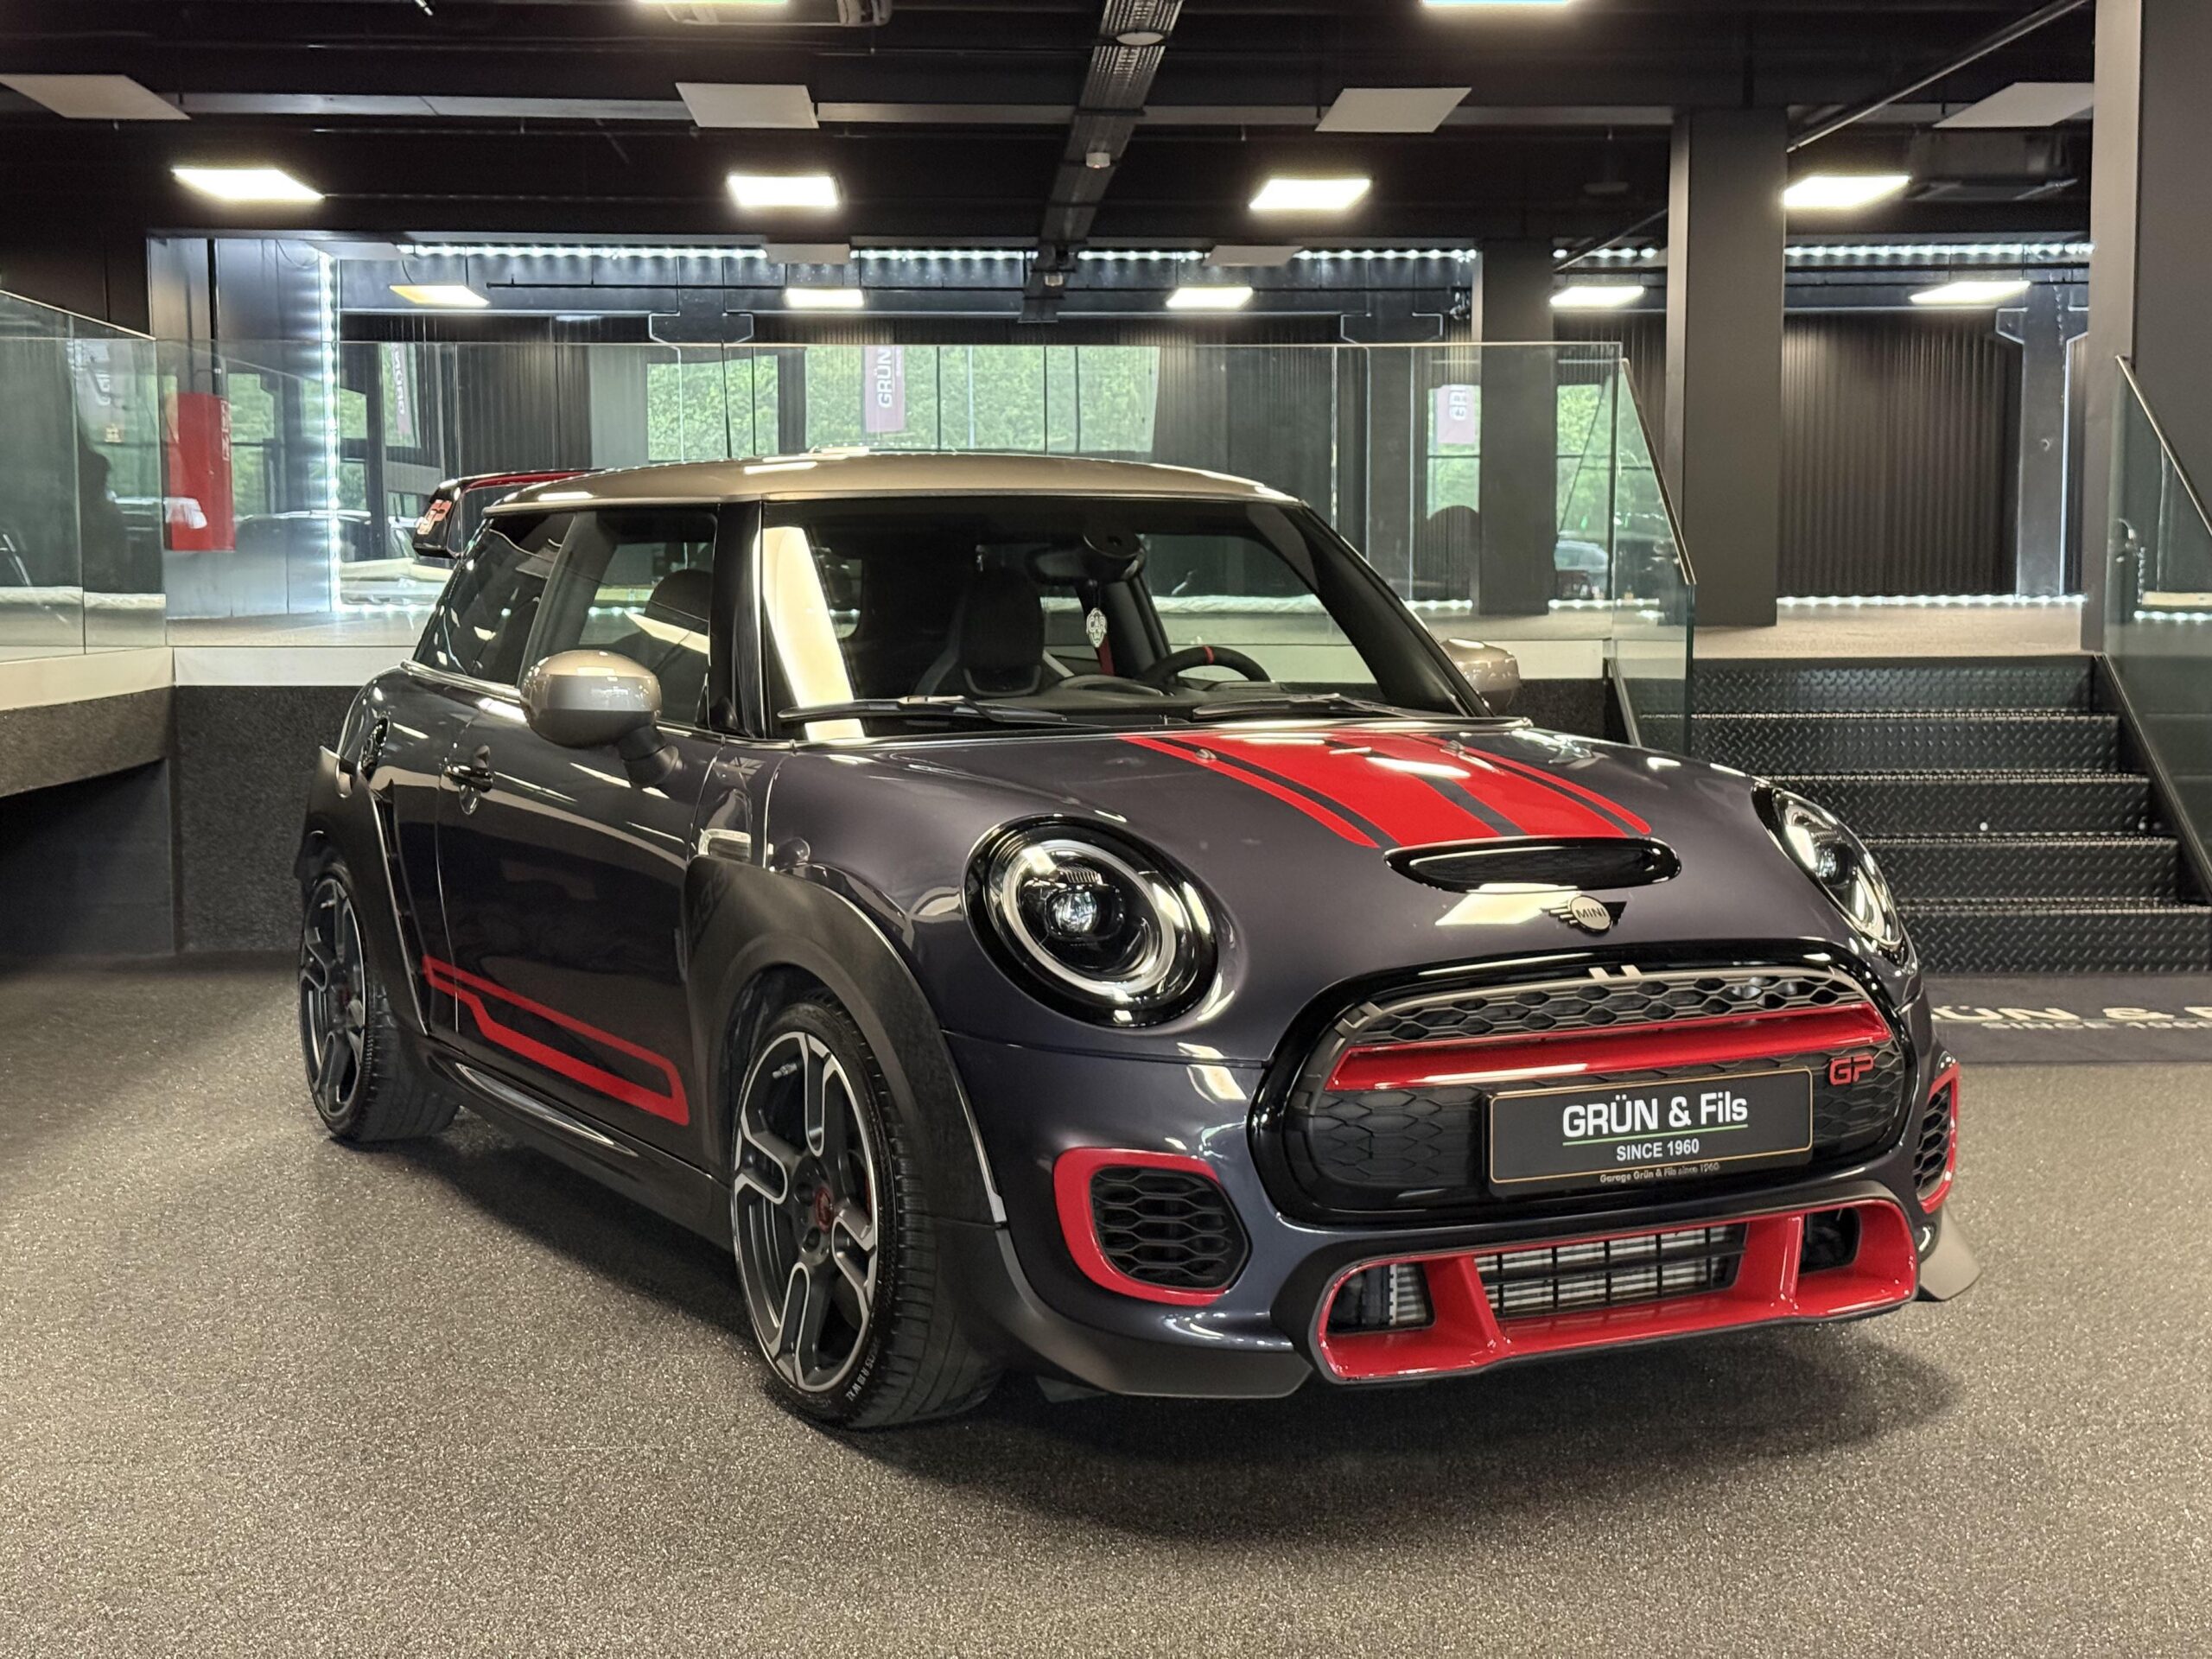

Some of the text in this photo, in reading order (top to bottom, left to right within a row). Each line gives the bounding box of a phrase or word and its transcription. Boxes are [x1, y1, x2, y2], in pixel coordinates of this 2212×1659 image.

[874, 347, 893, 407] GRÜN
[1575, 907, 1606, 918] MINI
[1930, 1006, 2081, 1020] ÜN
[2102, 1007, 2175, 1020] &
[1829, 1053, 1874, 1085] GP
[1562, 1090, 1748, 1138] GRÜN & Fils
[1616, 1138, 1700, 1161] SINCE 1960
[1599, 1173, 1631, 1183] Garage
[1633, 1170, 1654, 1179] Grün
[1656, 1168, 1662, 1177] &
